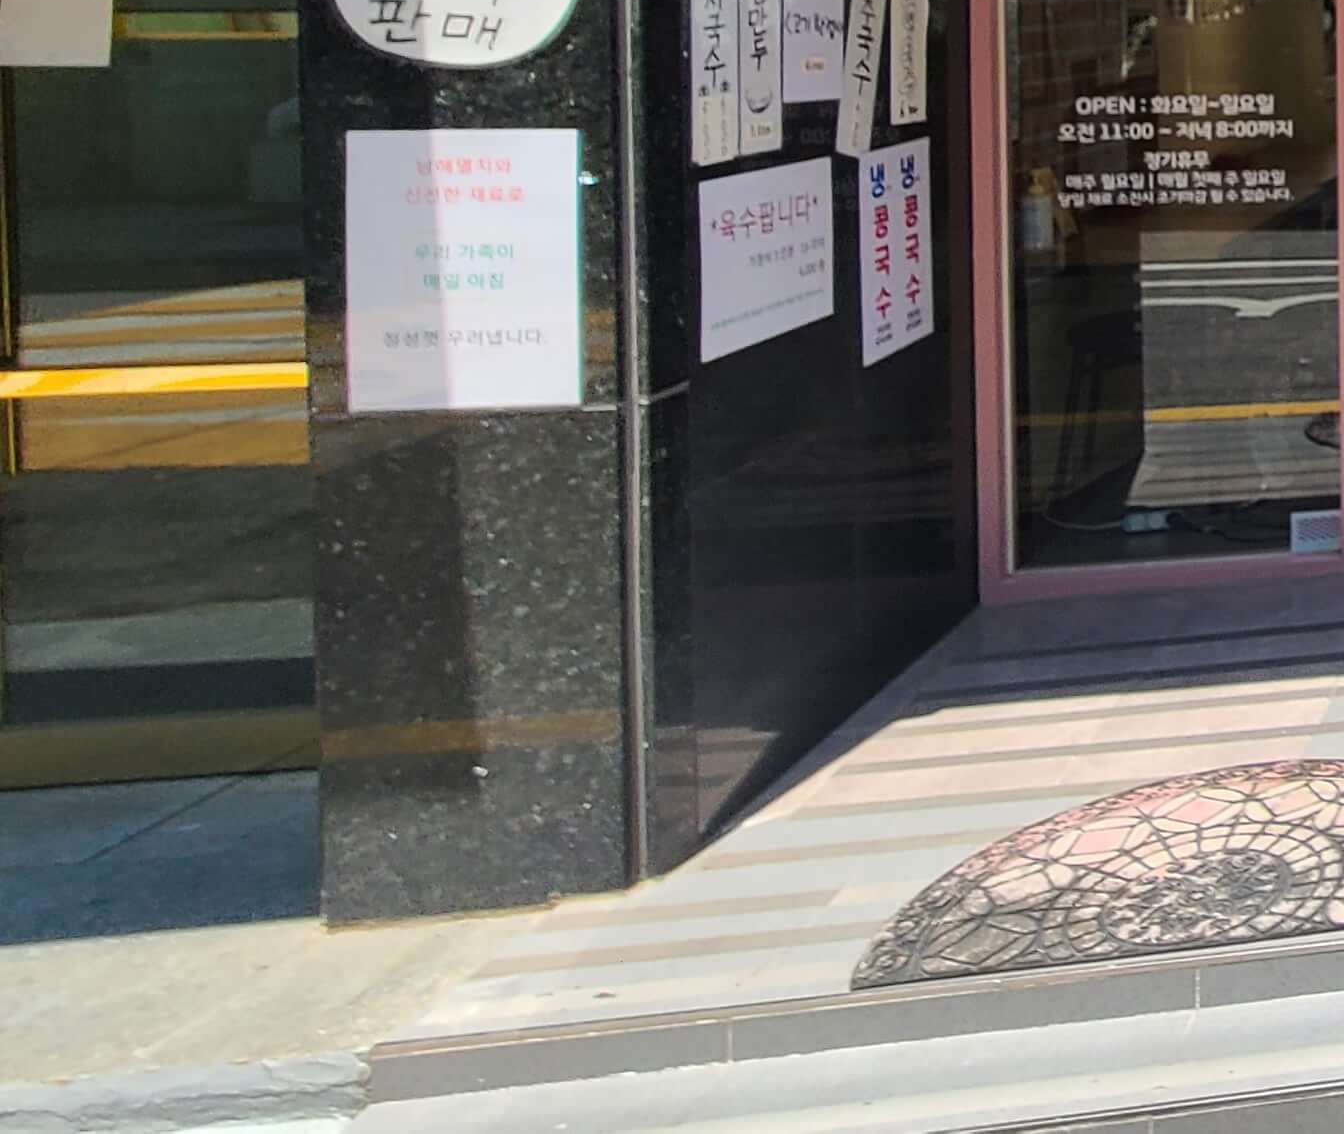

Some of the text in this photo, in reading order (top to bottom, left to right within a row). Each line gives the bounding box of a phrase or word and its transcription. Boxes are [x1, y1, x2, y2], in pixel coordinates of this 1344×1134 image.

[1075, 96, 1136, 115] OPEN
[1057, 123, 1096, 144] 오전
[1100, 122, 1154, 140] 11:00
[1175, 121, 1212, 141] 저녁
[1215, 119, 1293, 138] 8:00까지
[1144, 150, 1211, 171] 정기휴무
[1065, 174, 1097, 190] 매주
[1242, 169, 1286, 186] 일요일
[415, 244, 514, 260] 우리 가족이
